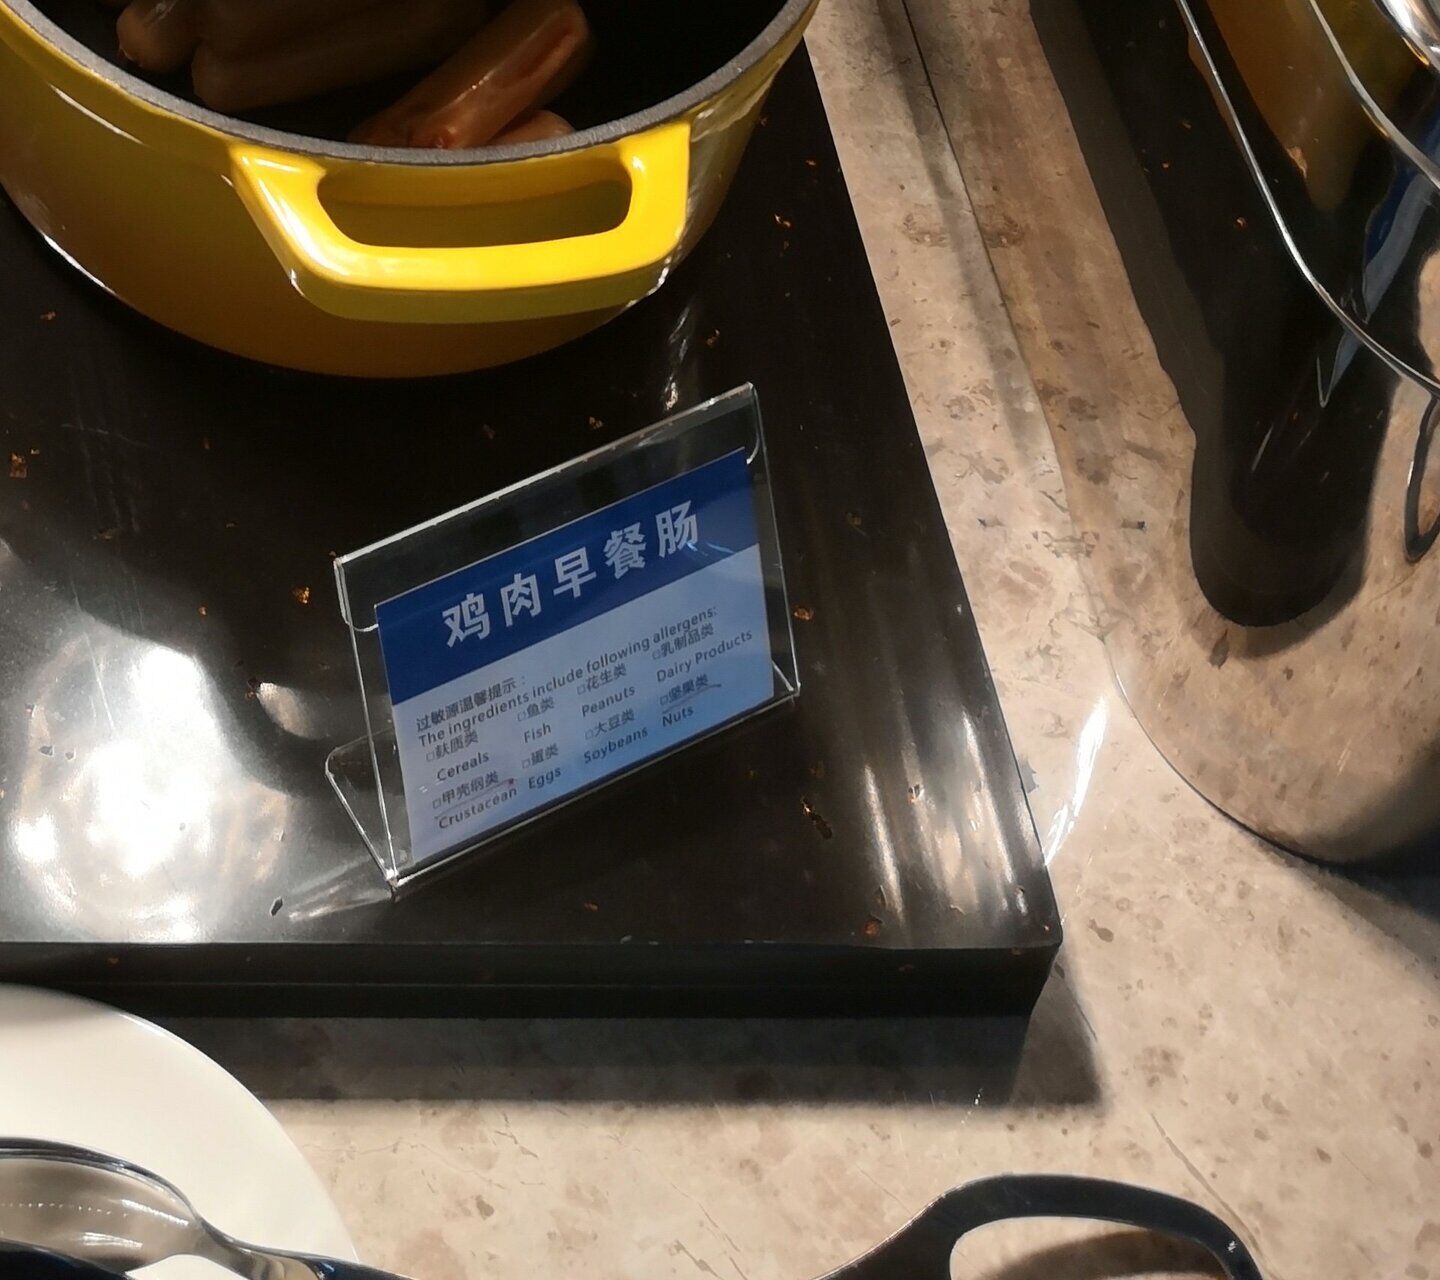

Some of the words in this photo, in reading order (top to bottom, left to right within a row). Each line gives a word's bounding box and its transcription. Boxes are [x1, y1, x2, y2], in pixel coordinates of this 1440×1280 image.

[442, 500, 699, 647] 鸡肉早餐肠
[661, 623, 714, 658] 乳制品类
[656, 659, 692, 683] Dairy
[695, 630, 753, 664] Products
[419, 729, 446, 748] The
[448, 690, 530, 734] ingredients
[532, 668, 584, 698] include
[586, 638, 650, 672] following
[653, 606, 718, 645] allergens:
[586, 662, 627, 691] 花生类
[527, 697, 555, 720] 鱼类
[581, 685, 636, 718] Peanuts
[662, 706, 695, 728] Nuts
[524, 723, 552, 744] Fish
[595, 708, 635, 737] 大豆类
[584, 725, 649, 764] Soybeans
[437, 751, 490, 781] Cereals
[528, 768, 562, 790] Eggs
[438, 786, 517, 829] Crustacean
